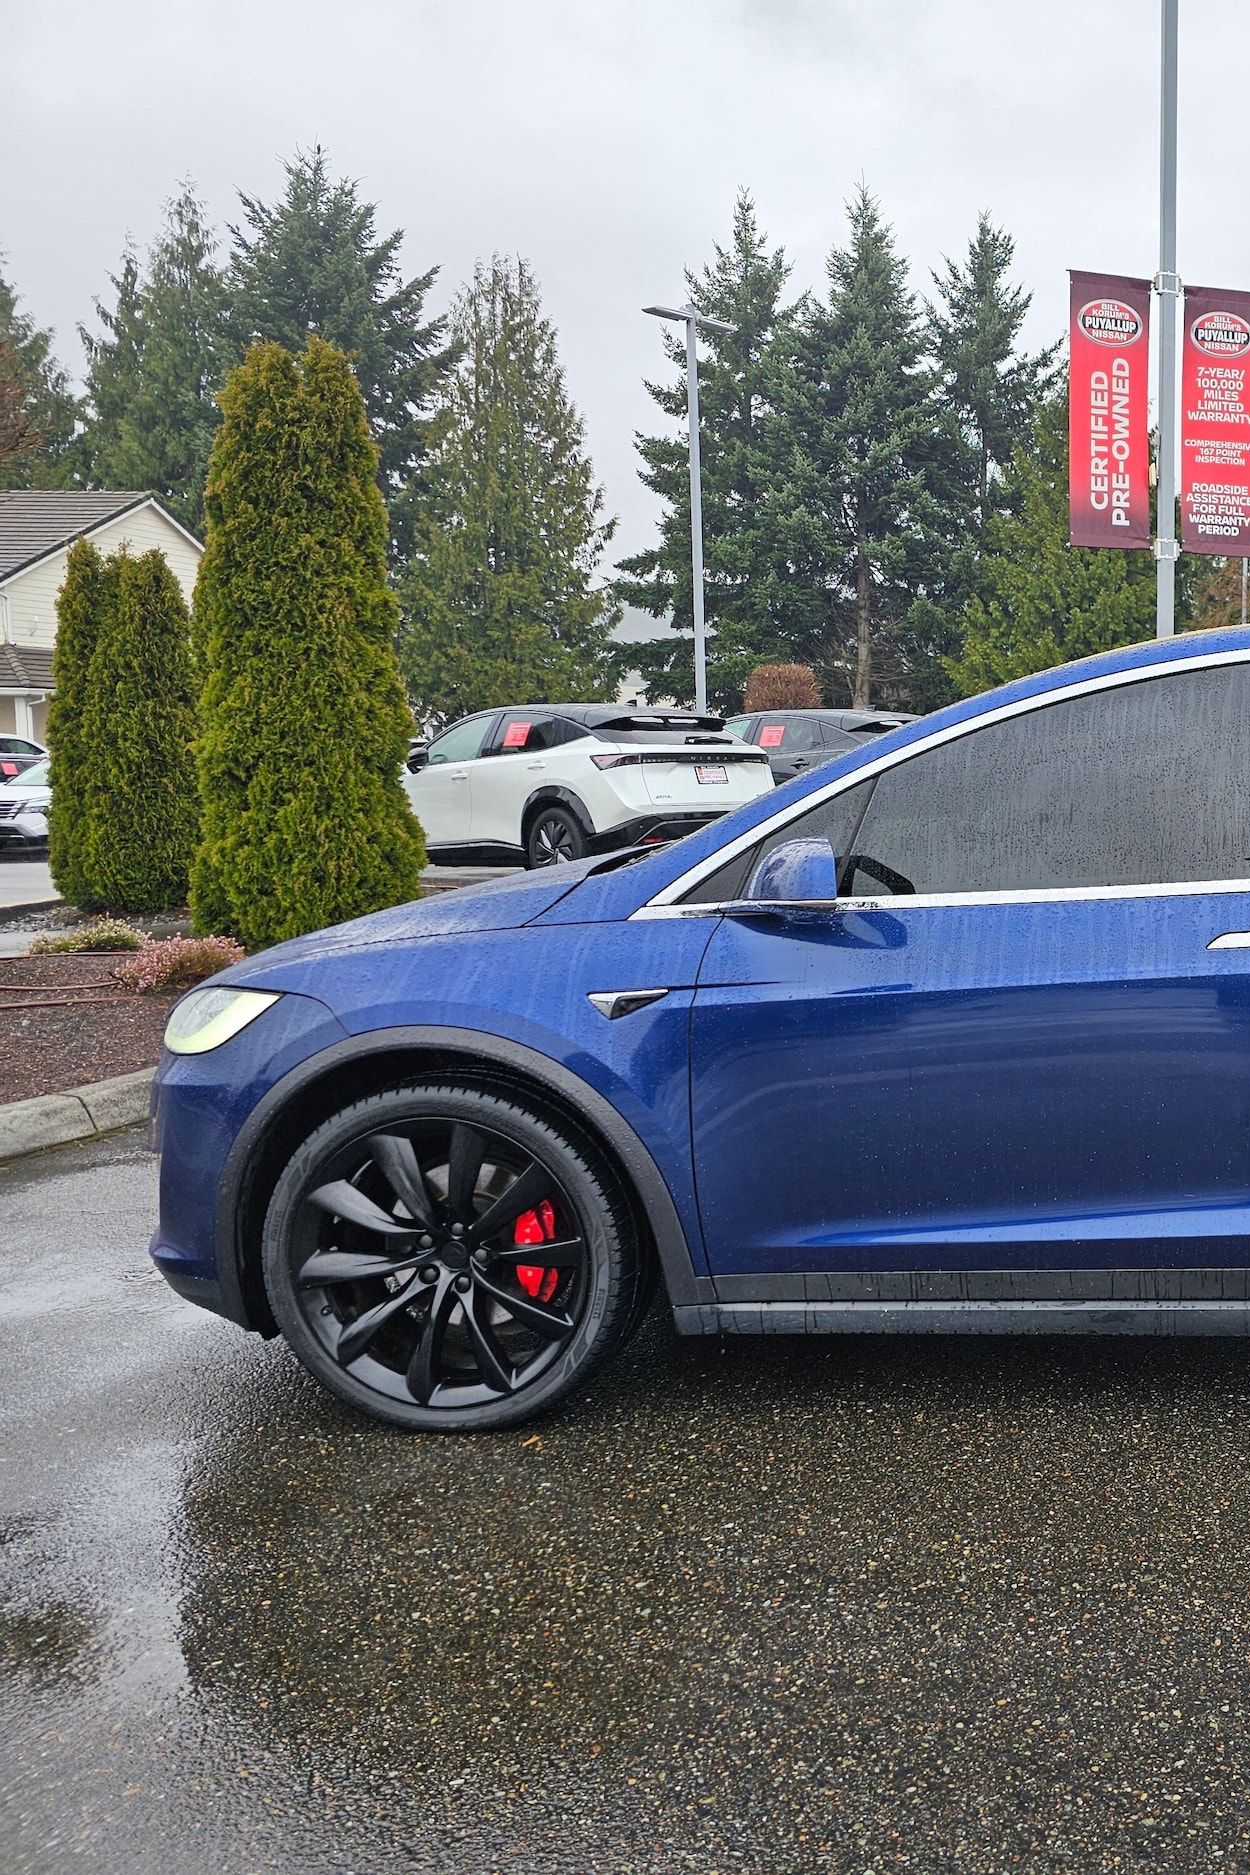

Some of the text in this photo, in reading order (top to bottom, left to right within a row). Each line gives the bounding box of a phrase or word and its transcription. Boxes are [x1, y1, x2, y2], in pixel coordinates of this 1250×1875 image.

[1092, 308, 1130, 319] KORUM'S
[1101, 303, 1120, 311] BILL
[1085, 316, 1136, 333] PUYALLUP
[1213, 315, 1232, 323] BILL
[1204, 321, 1242, 331] KORUM'S
[1092, 330, 1128, 341] NISSAN
[1197, 328, 1248, 344] PUYALLUP
[1204, 341, 1240, 351] NISSAN
[1197, 366, 1245, 380] 7-YEAR/
[1195, 377, 1244, 391] 100,000
[1203, 389, 1240, 401] MILES
[1197, 400, 1245, 413] LIMITED
[1090, 371, 1109, 510] CERTIFIED
[1112, 357, 1130, 526] PRE-OWNED
[1215, 449, 1242, 458] POINT
[1195, 455, 1245, 466] INSPECTION
[1192, 482, 1248, 496] ROADSIDE
[1193, 503, 1245, 516] FOR FULL
[1188, 513, 1250, 527] WARRANTY
[1198, 524, 1240, 537] PERIOD
